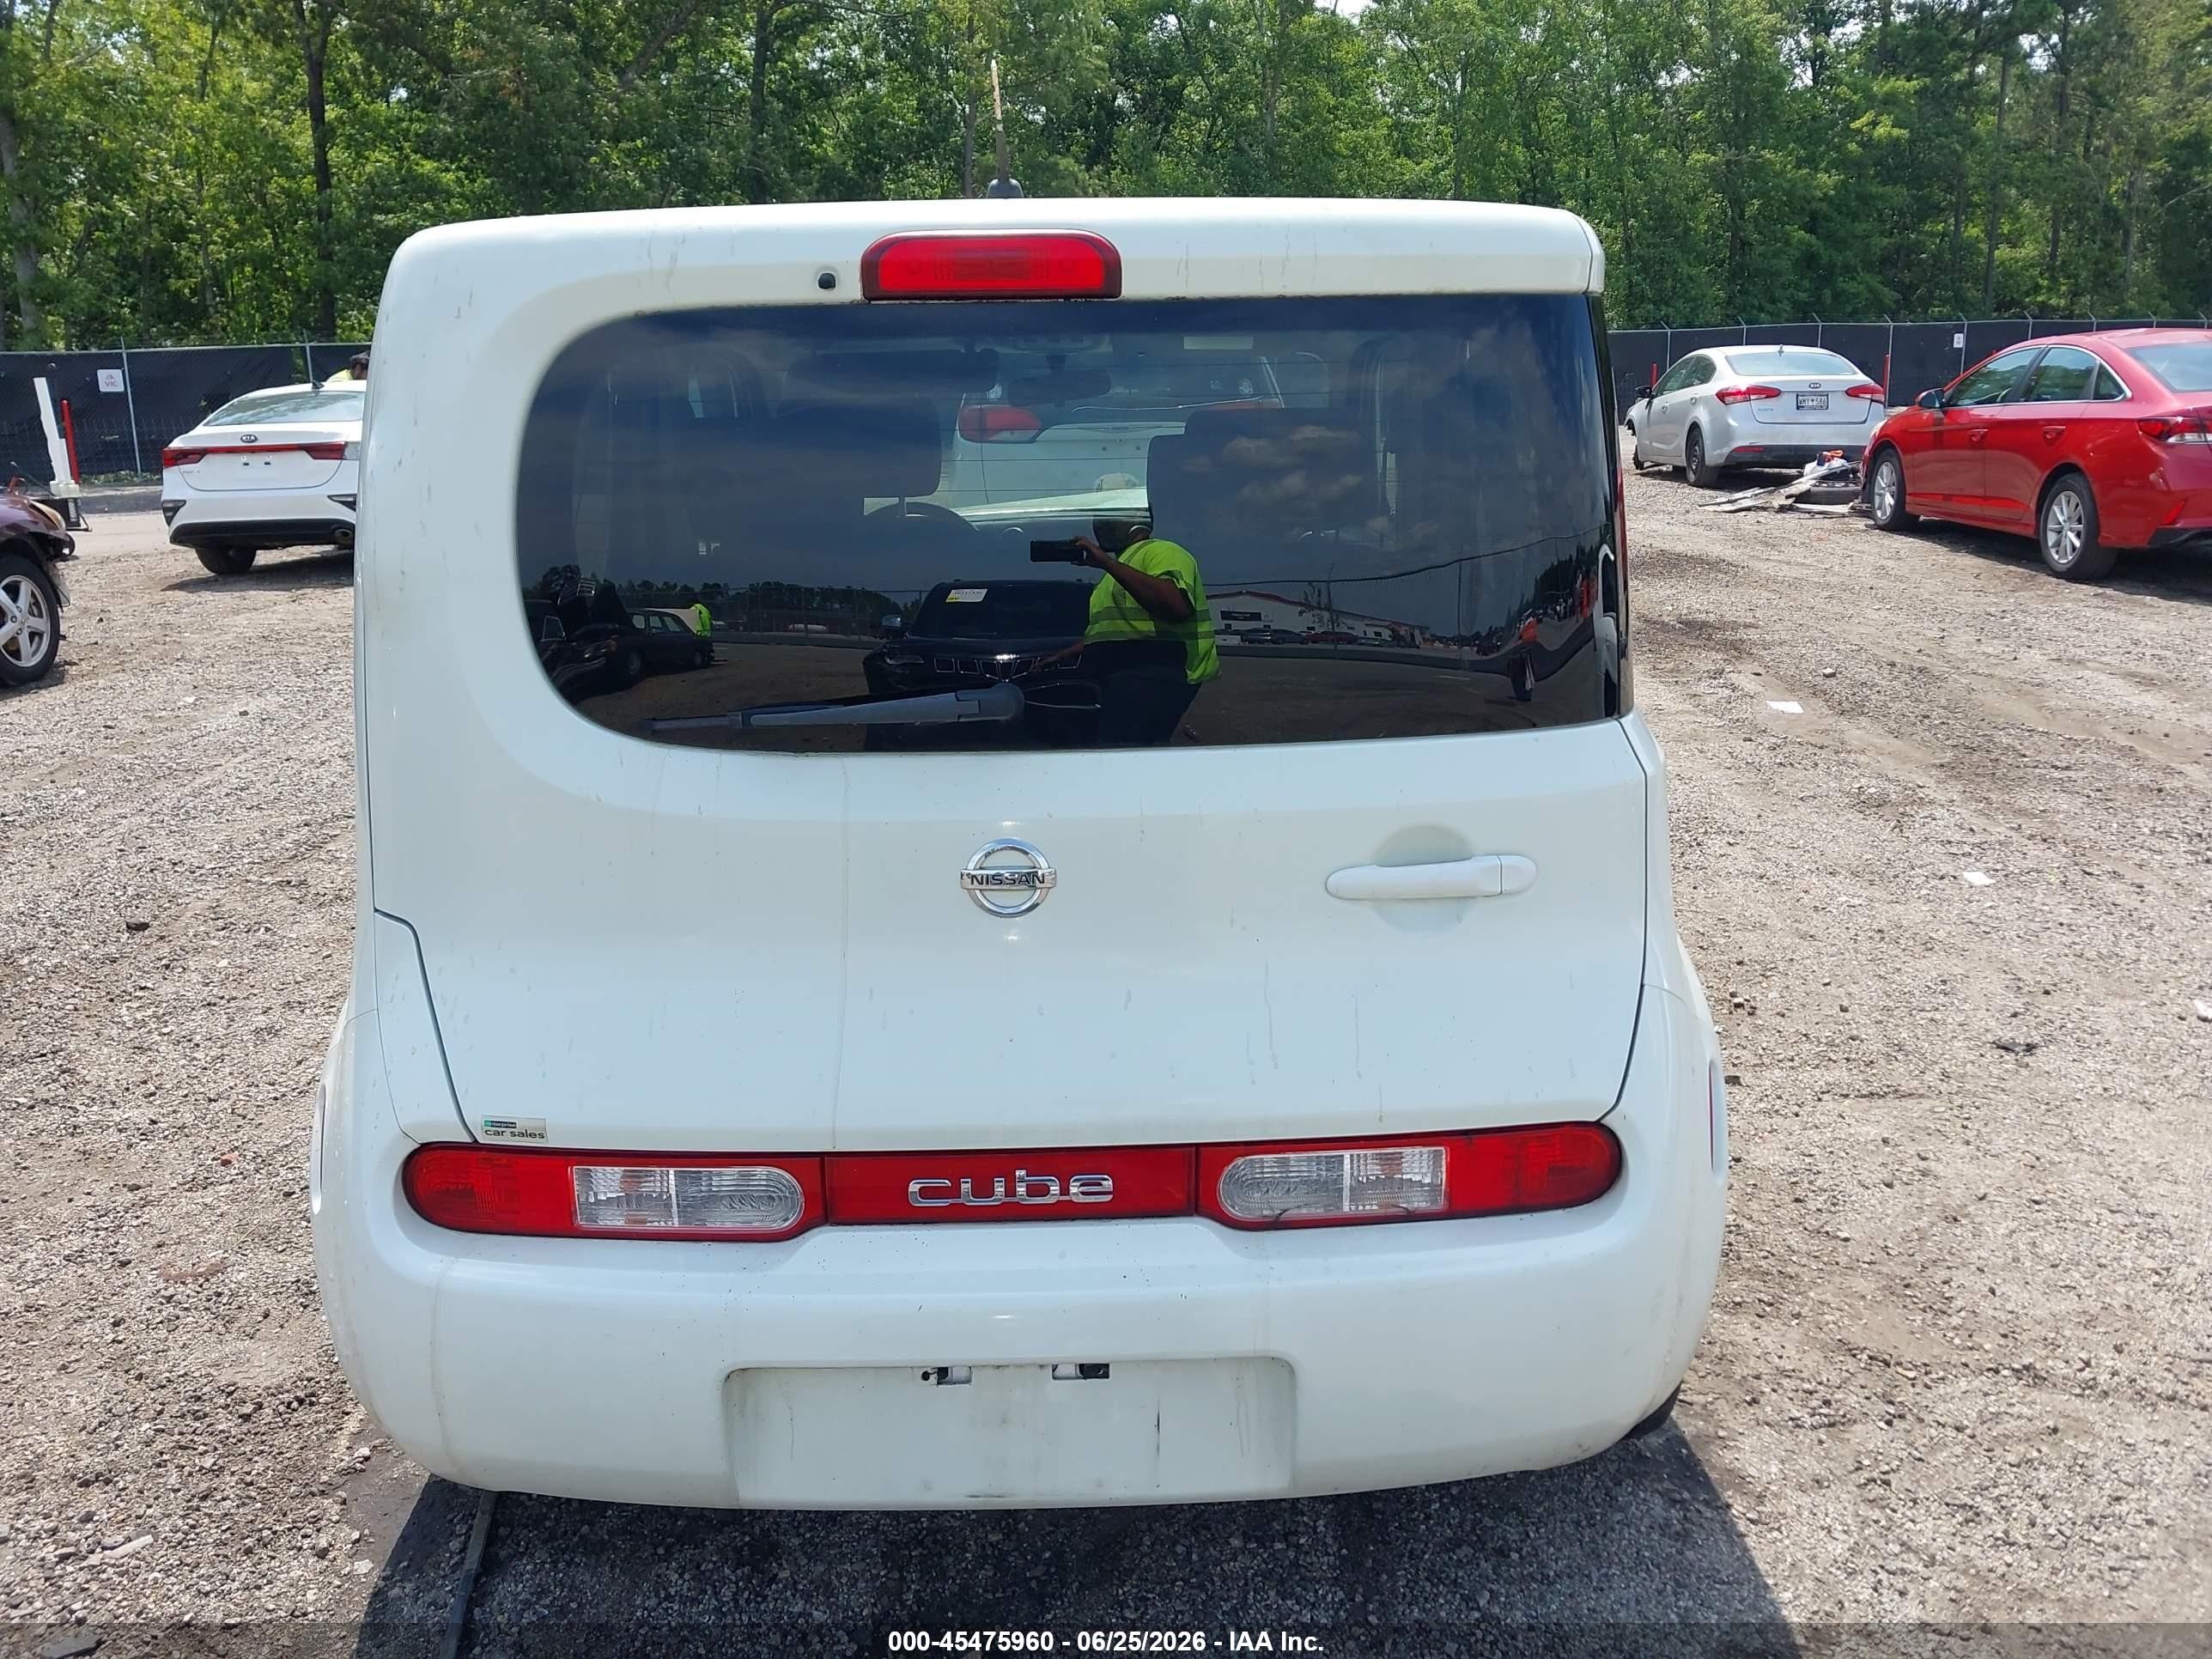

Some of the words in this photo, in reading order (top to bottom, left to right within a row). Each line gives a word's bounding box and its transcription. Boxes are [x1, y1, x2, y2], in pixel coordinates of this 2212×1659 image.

[970, 872, 1045, 885] NISSAN
[509, 1128, 545, 1139] sales
[908, 1169, 1114, 1206] cube
